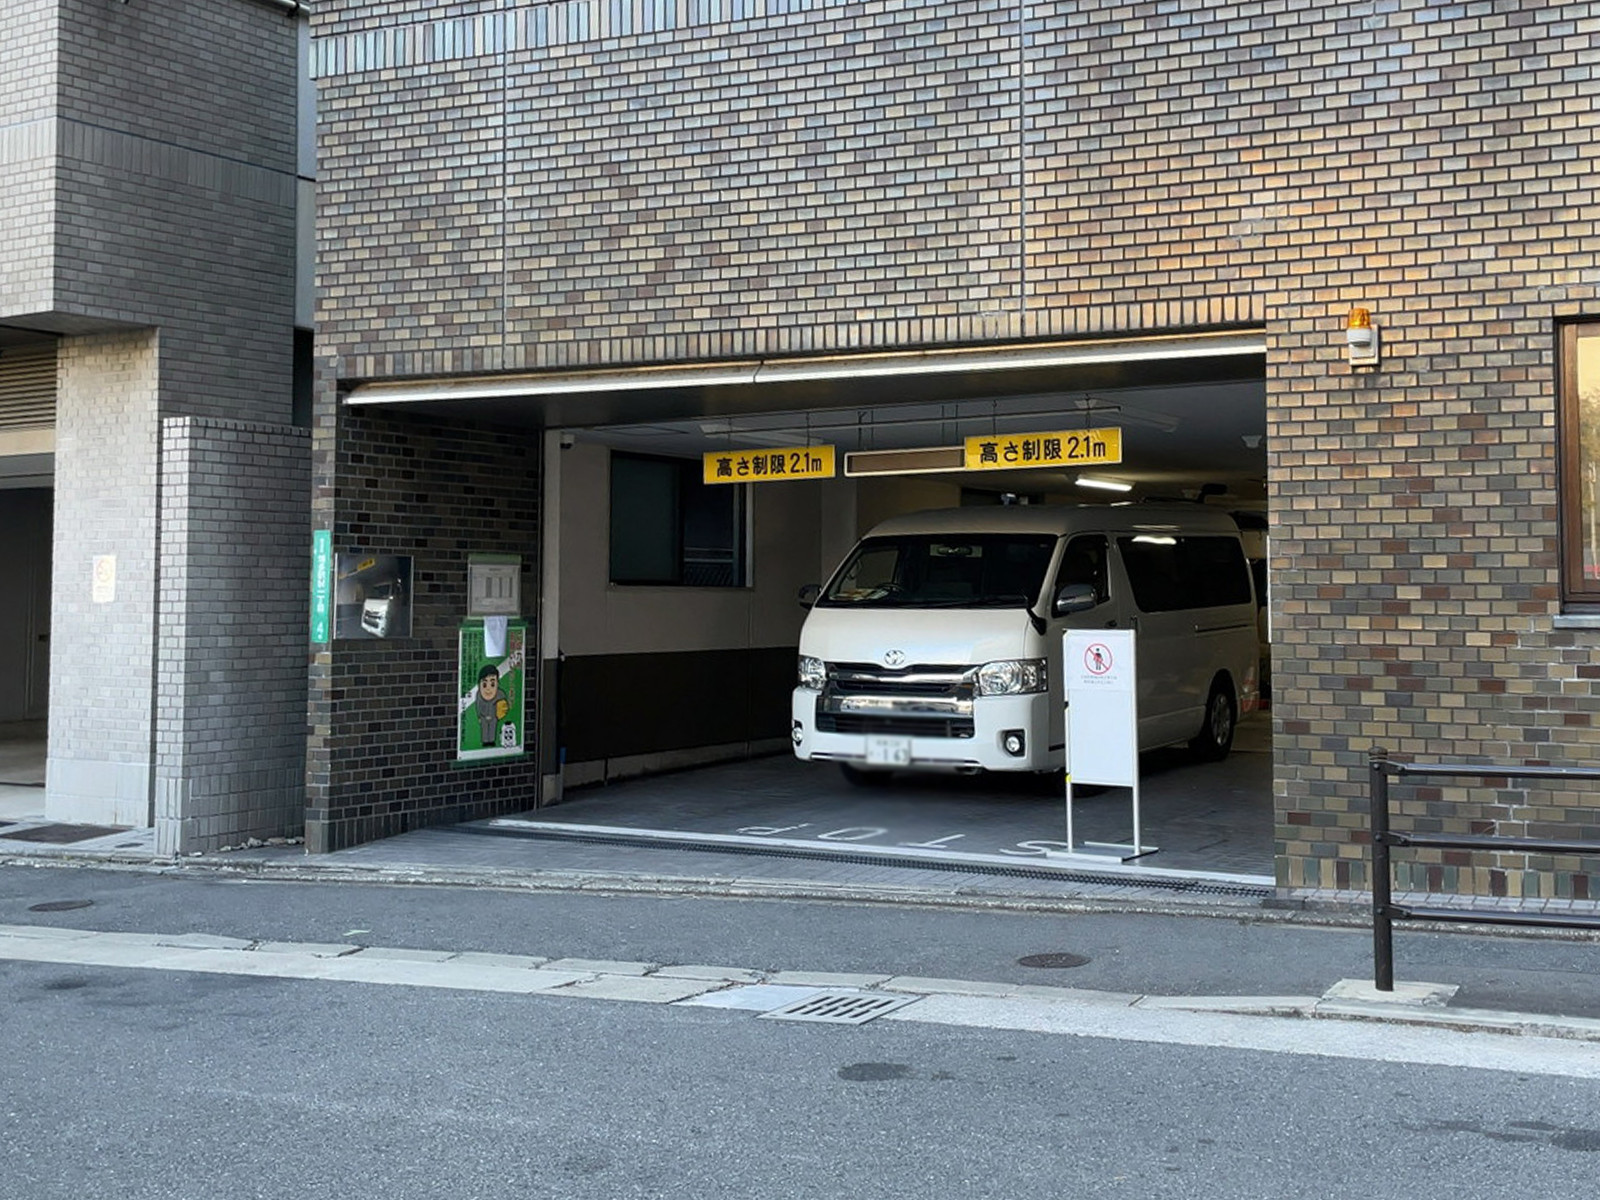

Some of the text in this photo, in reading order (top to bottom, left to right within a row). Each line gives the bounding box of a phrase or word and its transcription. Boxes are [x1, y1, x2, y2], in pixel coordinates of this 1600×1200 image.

[979, 435, 1107, 464] 高さ制限2.1m
[716, 452, 823, 477] 高さ制限2.1m
